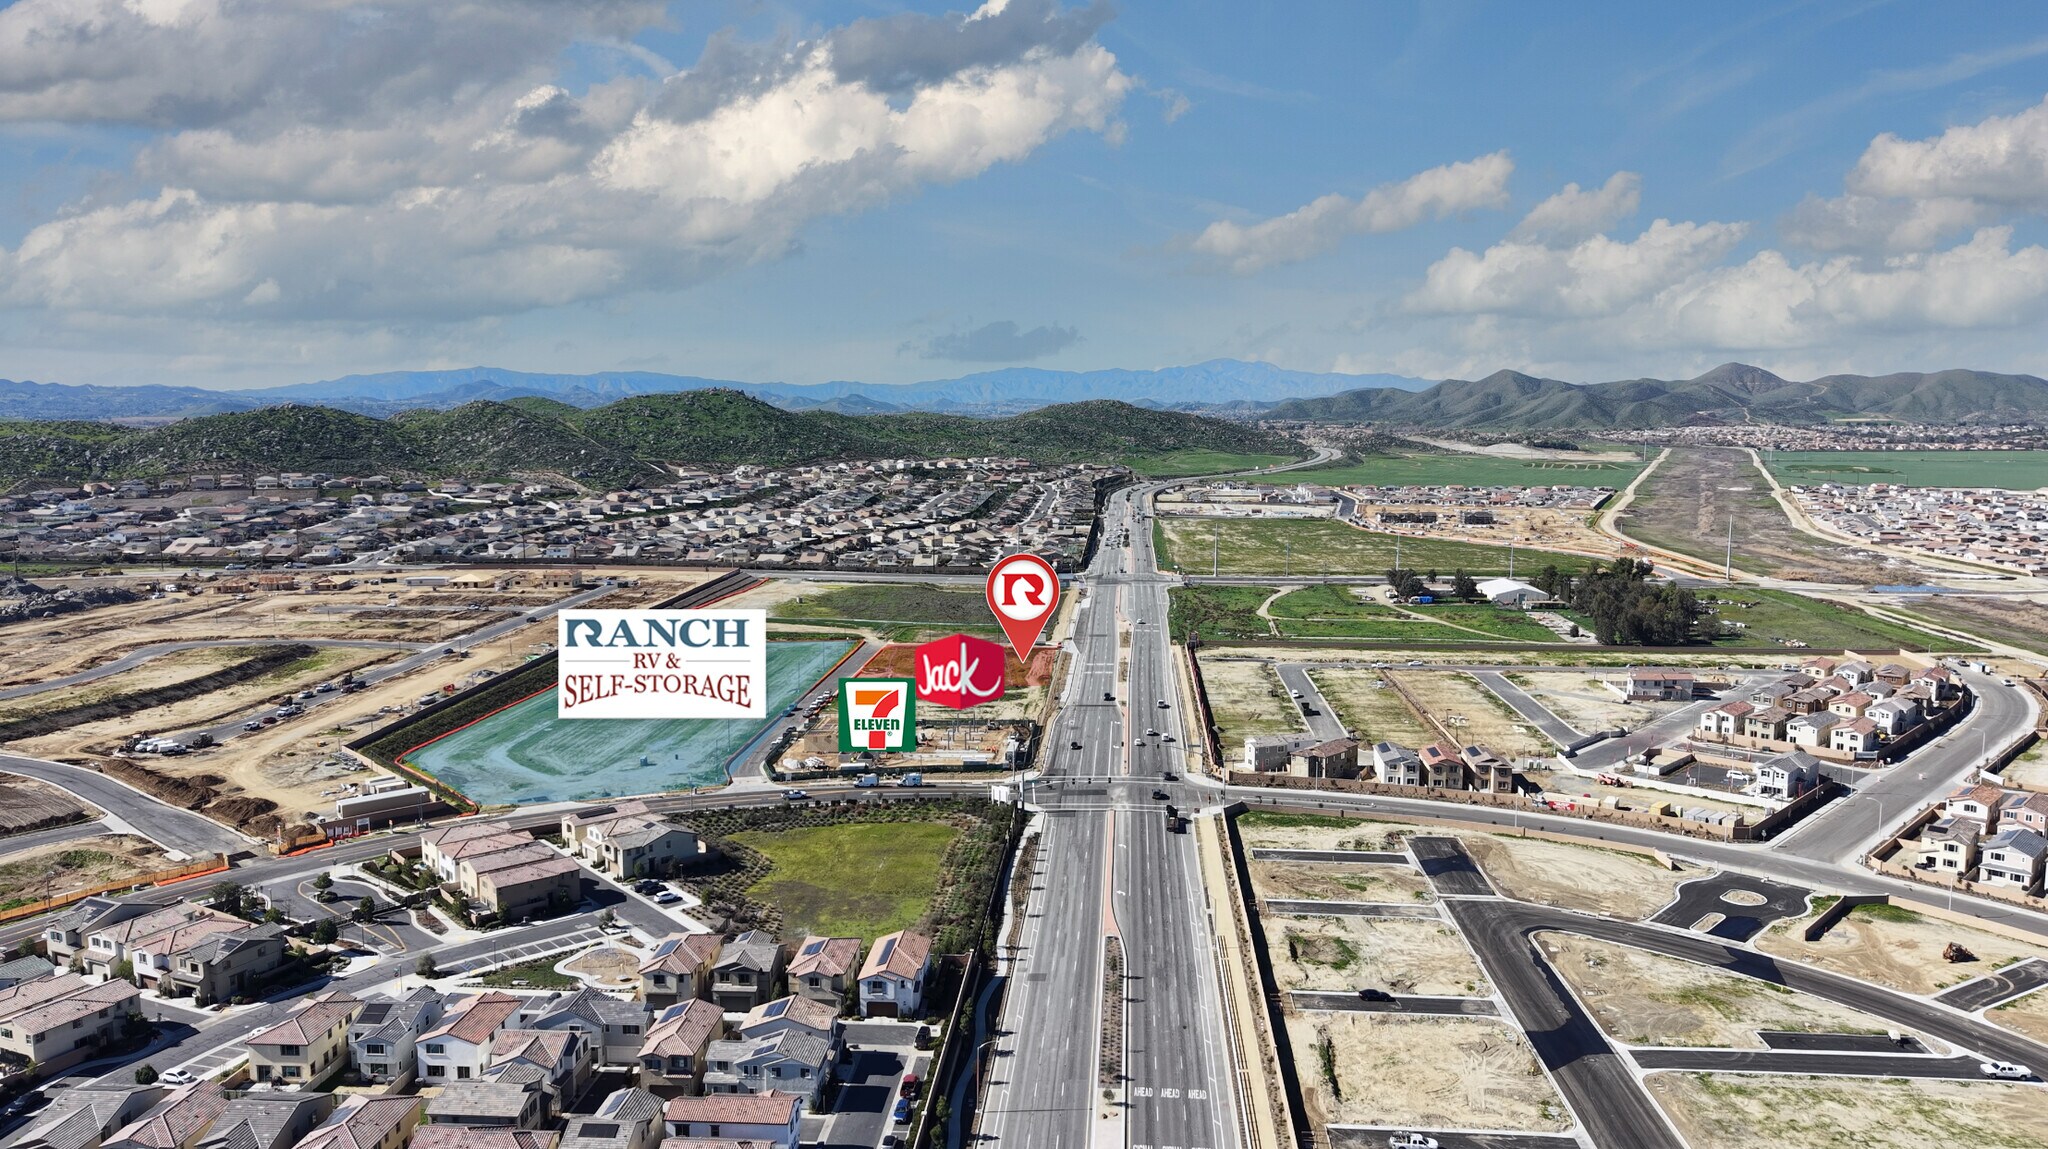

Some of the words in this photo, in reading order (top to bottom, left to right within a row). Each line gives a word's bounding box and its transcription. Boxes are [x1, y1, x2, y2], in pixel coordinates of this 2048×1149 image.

[1133, 1086, 1154, 1098] AHEAD
[1160, 1087, 1180, 1099] AHEAD
[1187, 1088, 1207, 1100] AHEAD
